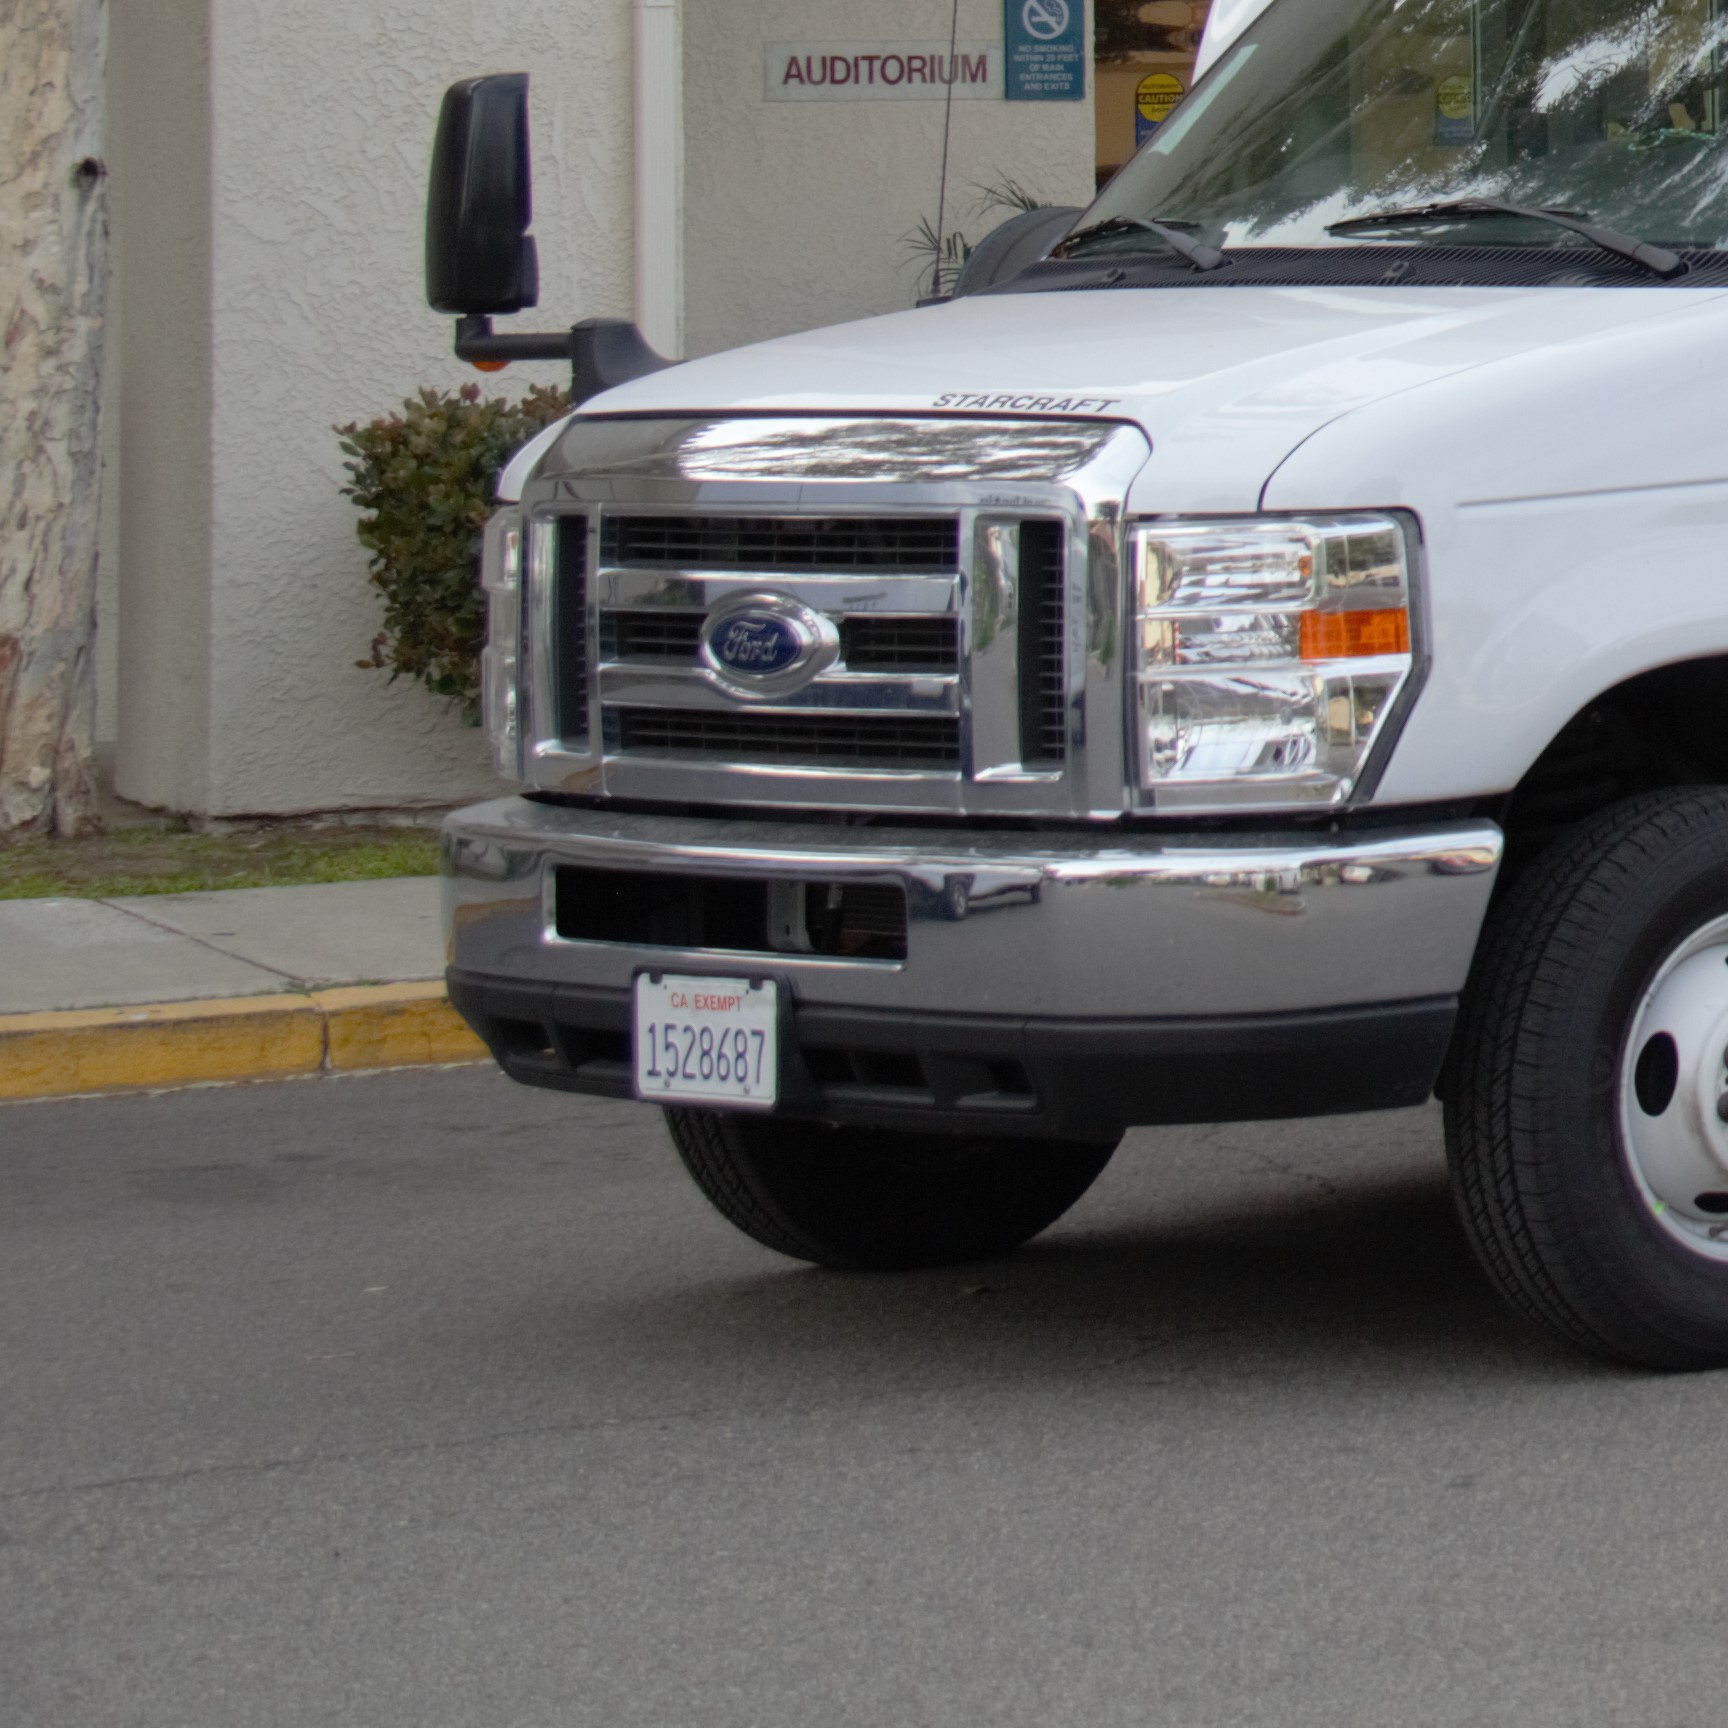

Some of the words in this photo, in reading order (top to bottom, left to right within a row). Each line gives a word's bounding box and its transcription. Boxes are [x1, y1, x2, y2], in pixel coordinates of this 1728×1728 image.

[1013, 54, 1044, 62] WITHIN
[1057, 54, 1079, 62] FEET
[782, 54, 987, 85] AUDITORIUM
[1019, 73, 1073, 81] ENTRANCES
[932, 393, 1122, 413] STARCRAFT
[723, 621, 779, 661] Ford
[671, 992, 688, 1010] CA
[694, 993, 742, 1012] EXEMPT
[646, 1022, 766, 1084] 1528687
